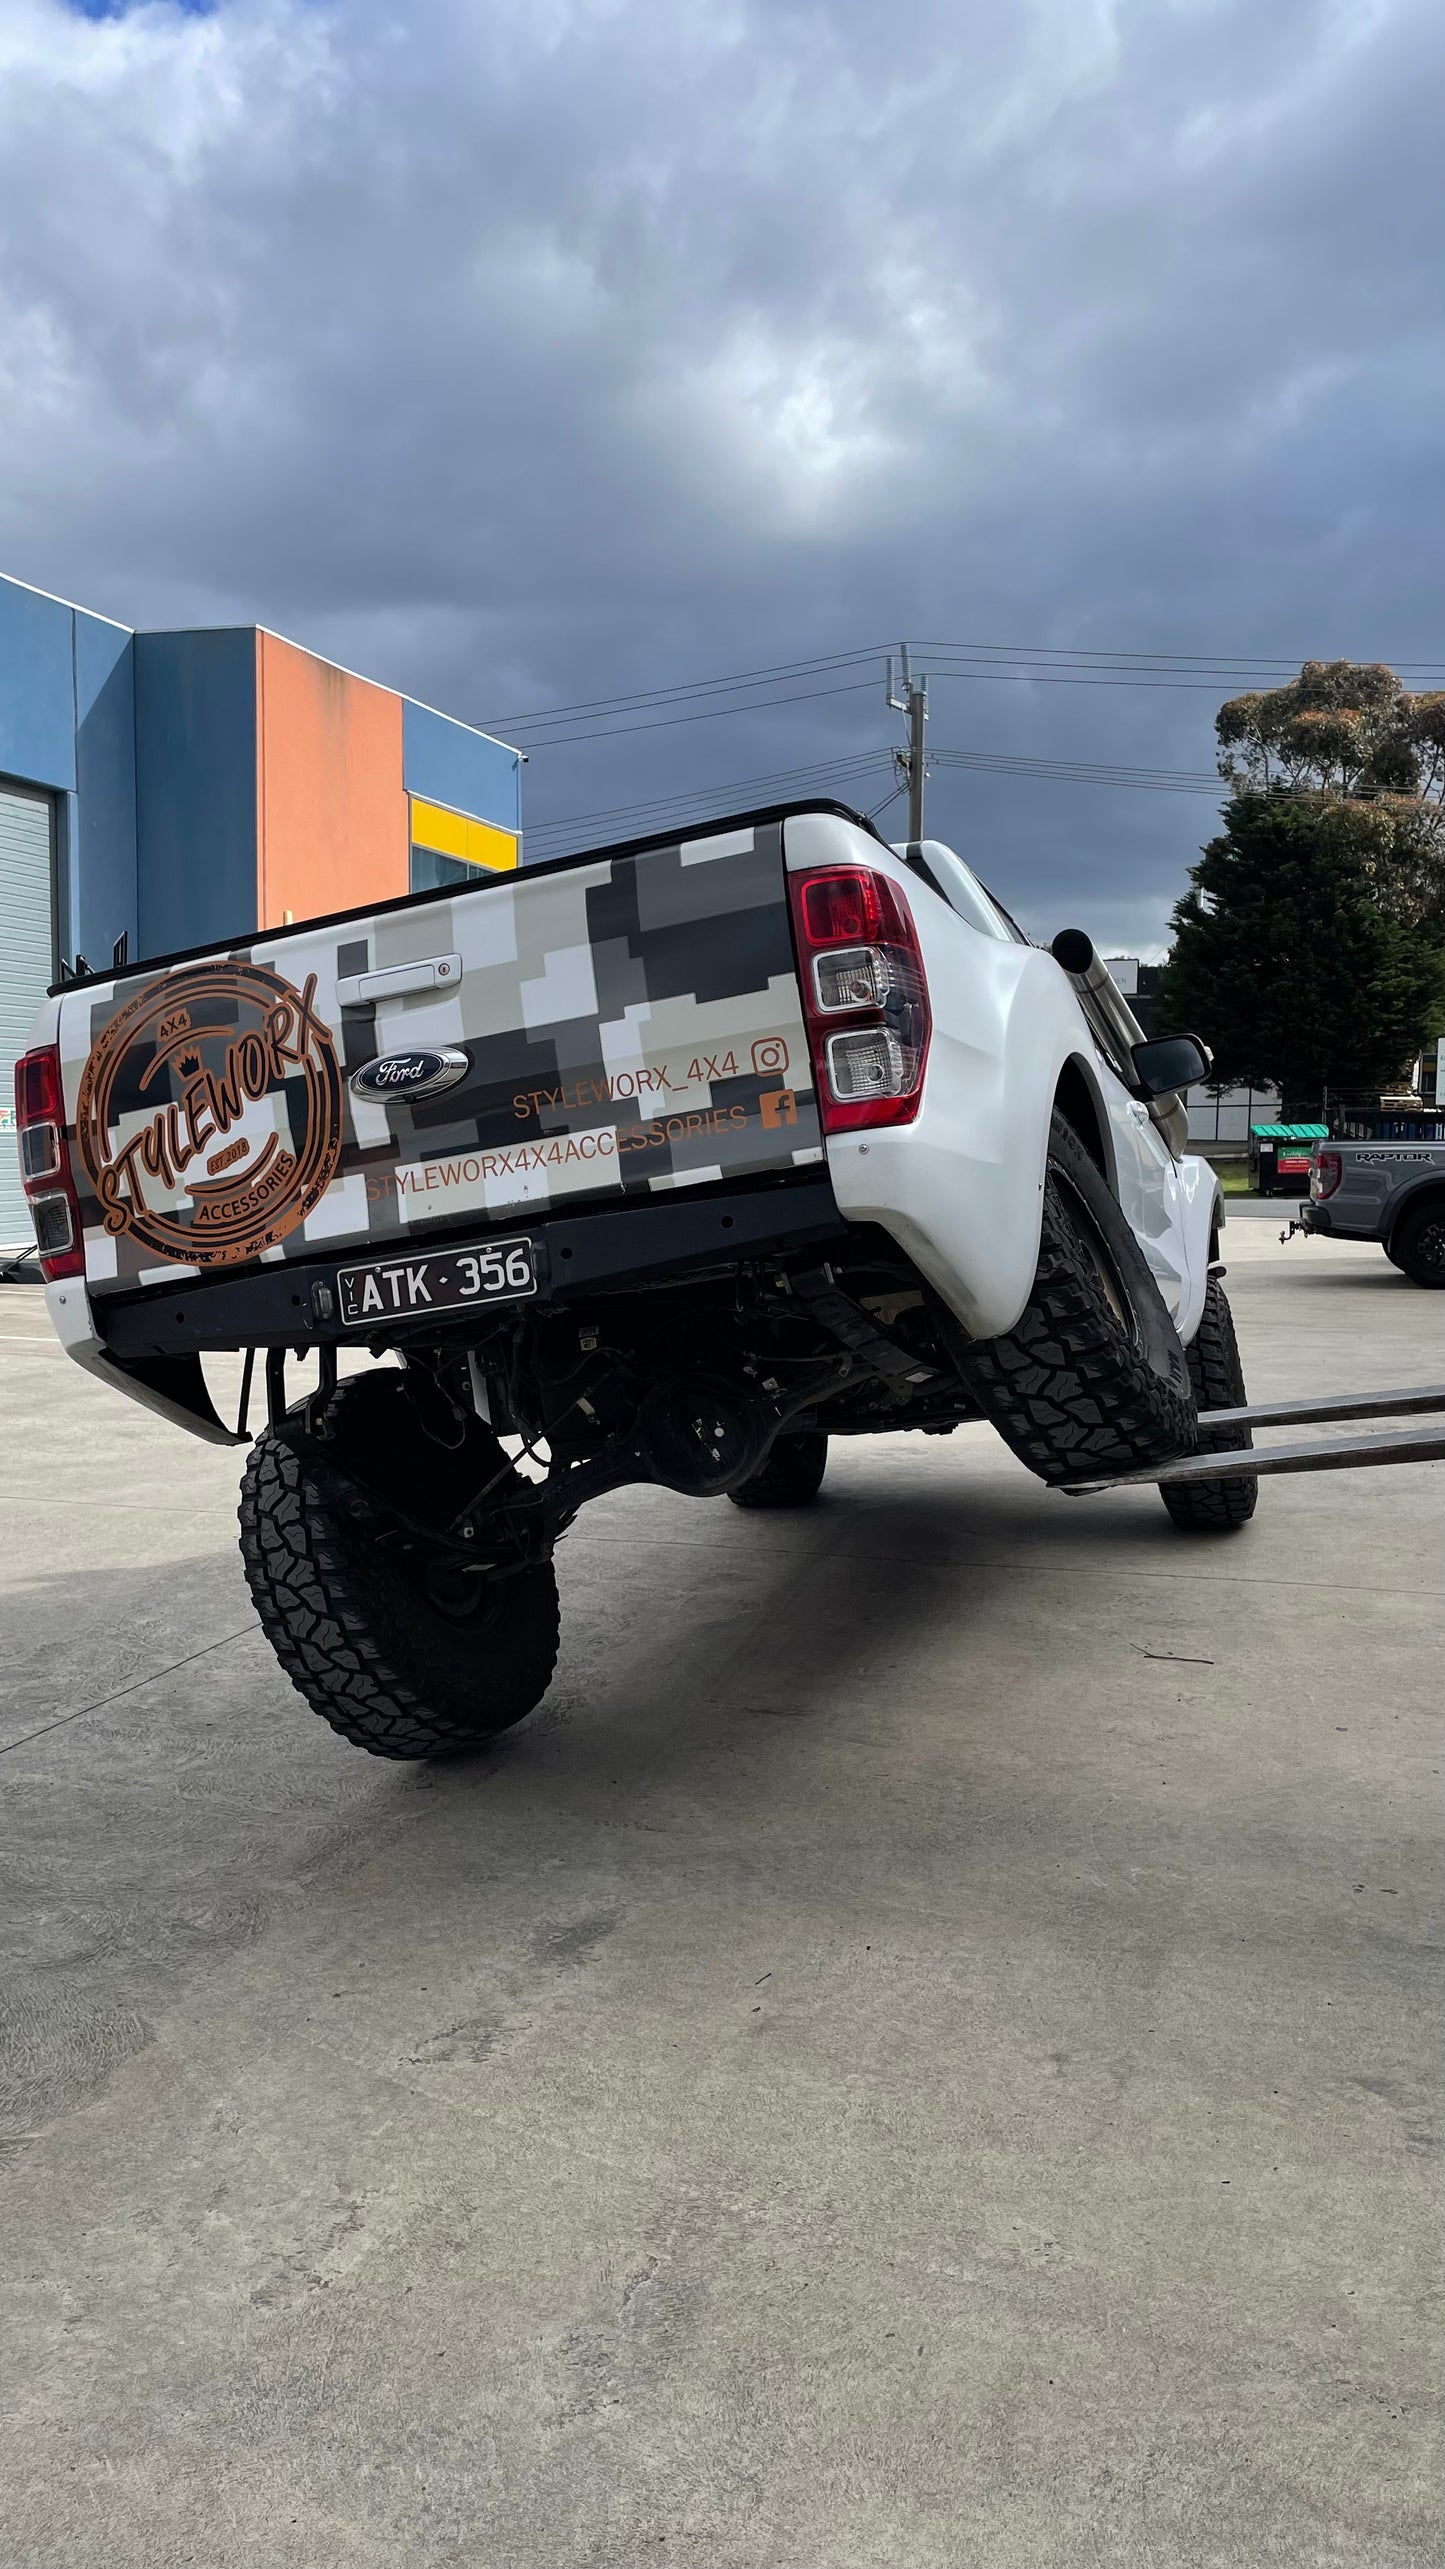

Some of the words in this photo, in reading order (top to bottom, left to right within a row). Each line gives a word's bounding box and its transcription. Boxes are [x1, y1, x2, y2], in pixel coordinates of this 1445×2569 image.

[160, 1013, 188, 1037] 4X4
[375, 1058, 424, 1085] Ford
[512, 1051, 740, 1119] STYLEWORX_4X4
[95, 974, 331, 1235] STYLEWORX
[365, 1106, 748, 1201] STYLEWORX4X4ACCESSORIES
[1356, 1153, 1436, 1165] RAPTOR
[199, 1154, 294, 1220] ACCESSORIES
[344, 1277, 359, 1315] VIC
[456, 1248, 531, 1296] 356
